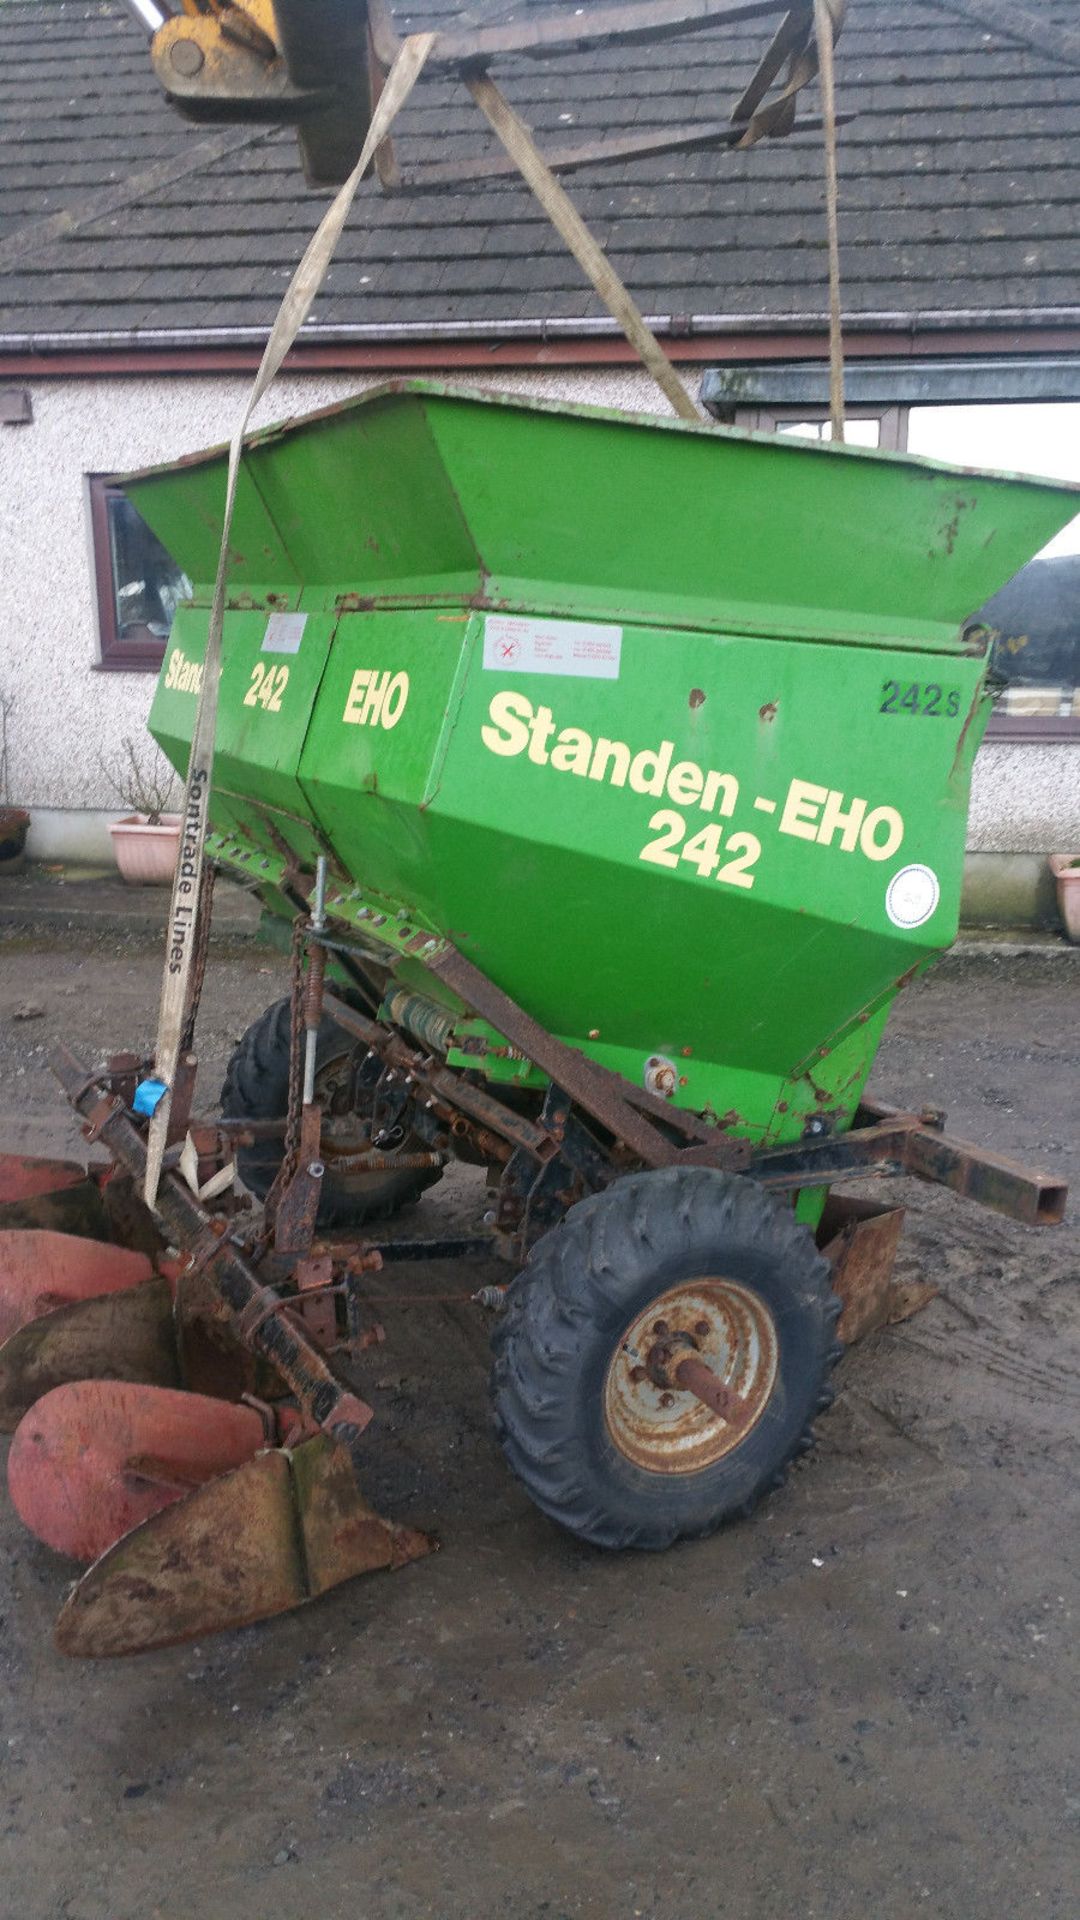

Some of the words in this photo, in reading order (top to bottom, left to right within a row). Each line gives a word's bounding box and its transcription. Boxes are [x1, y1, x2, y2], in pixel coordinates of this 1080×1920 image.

[165, 648, 223, 695] Stan
[243, 662, 289, 712] 242
[342, 669, 409, 730] EHO
[481, 691, 739, 817] Standen
[179, 768, 207, 894] Sontrade
[639, 809, 762, 889] 242
[168, 906, 192, 975] Lines
